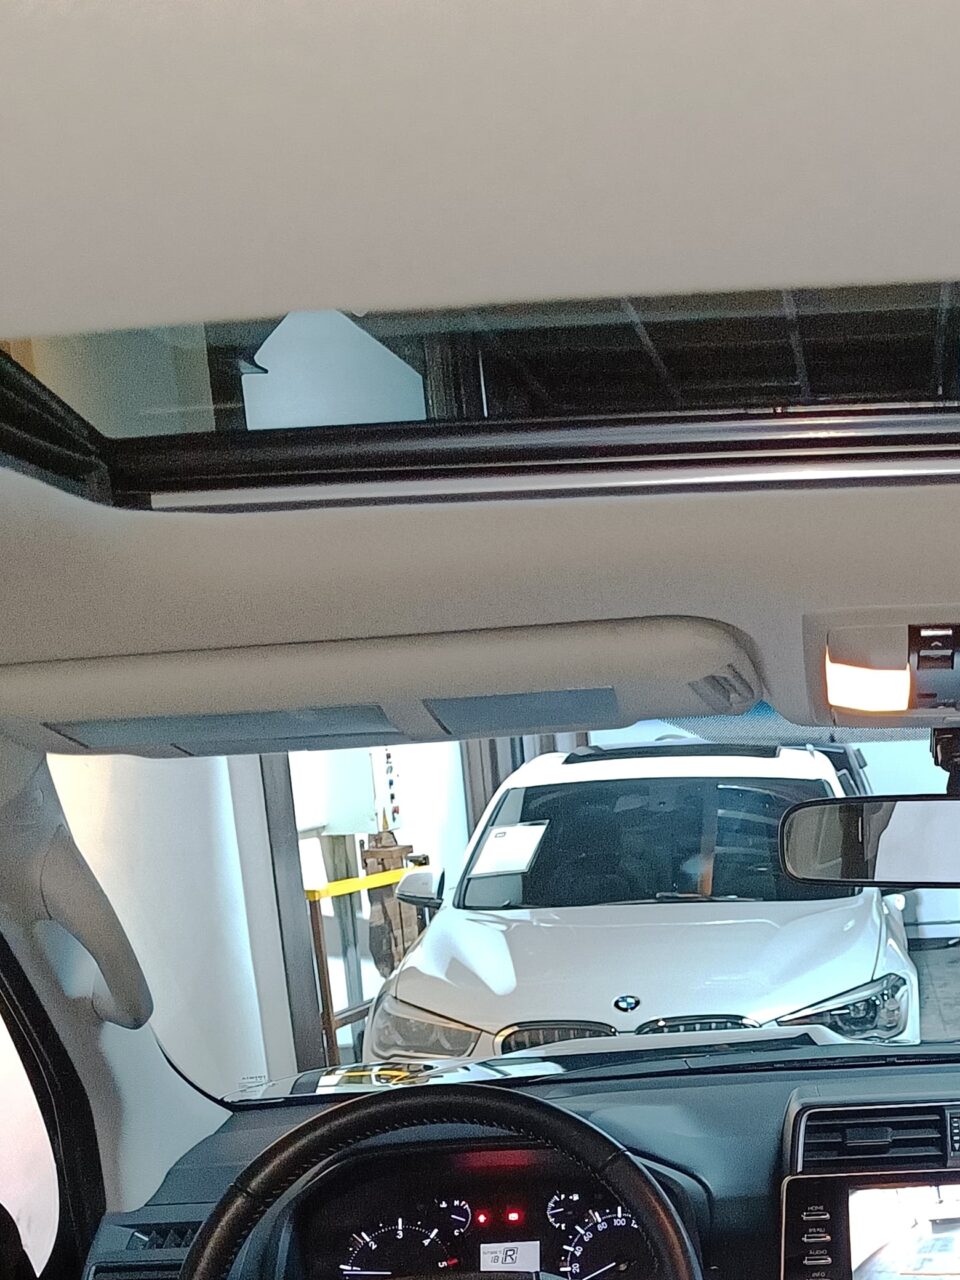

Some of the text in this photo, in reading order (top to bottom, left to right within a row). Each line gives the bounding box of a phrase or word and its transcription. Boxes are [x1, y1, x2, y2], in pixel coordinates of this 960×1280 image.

[613, 1218, 627, 1227] 100
[396, 1230, 404, 1239] 3
[583, 1231, 593, 1242] 60
[368, 1241, 378, 1251] 2
[422, 1238, 431, 1247] 4
[504, 1248, 516, 1262] R
[574, 1246, 583, 1257] 40
[572, 1263, 580, 1274] 20
